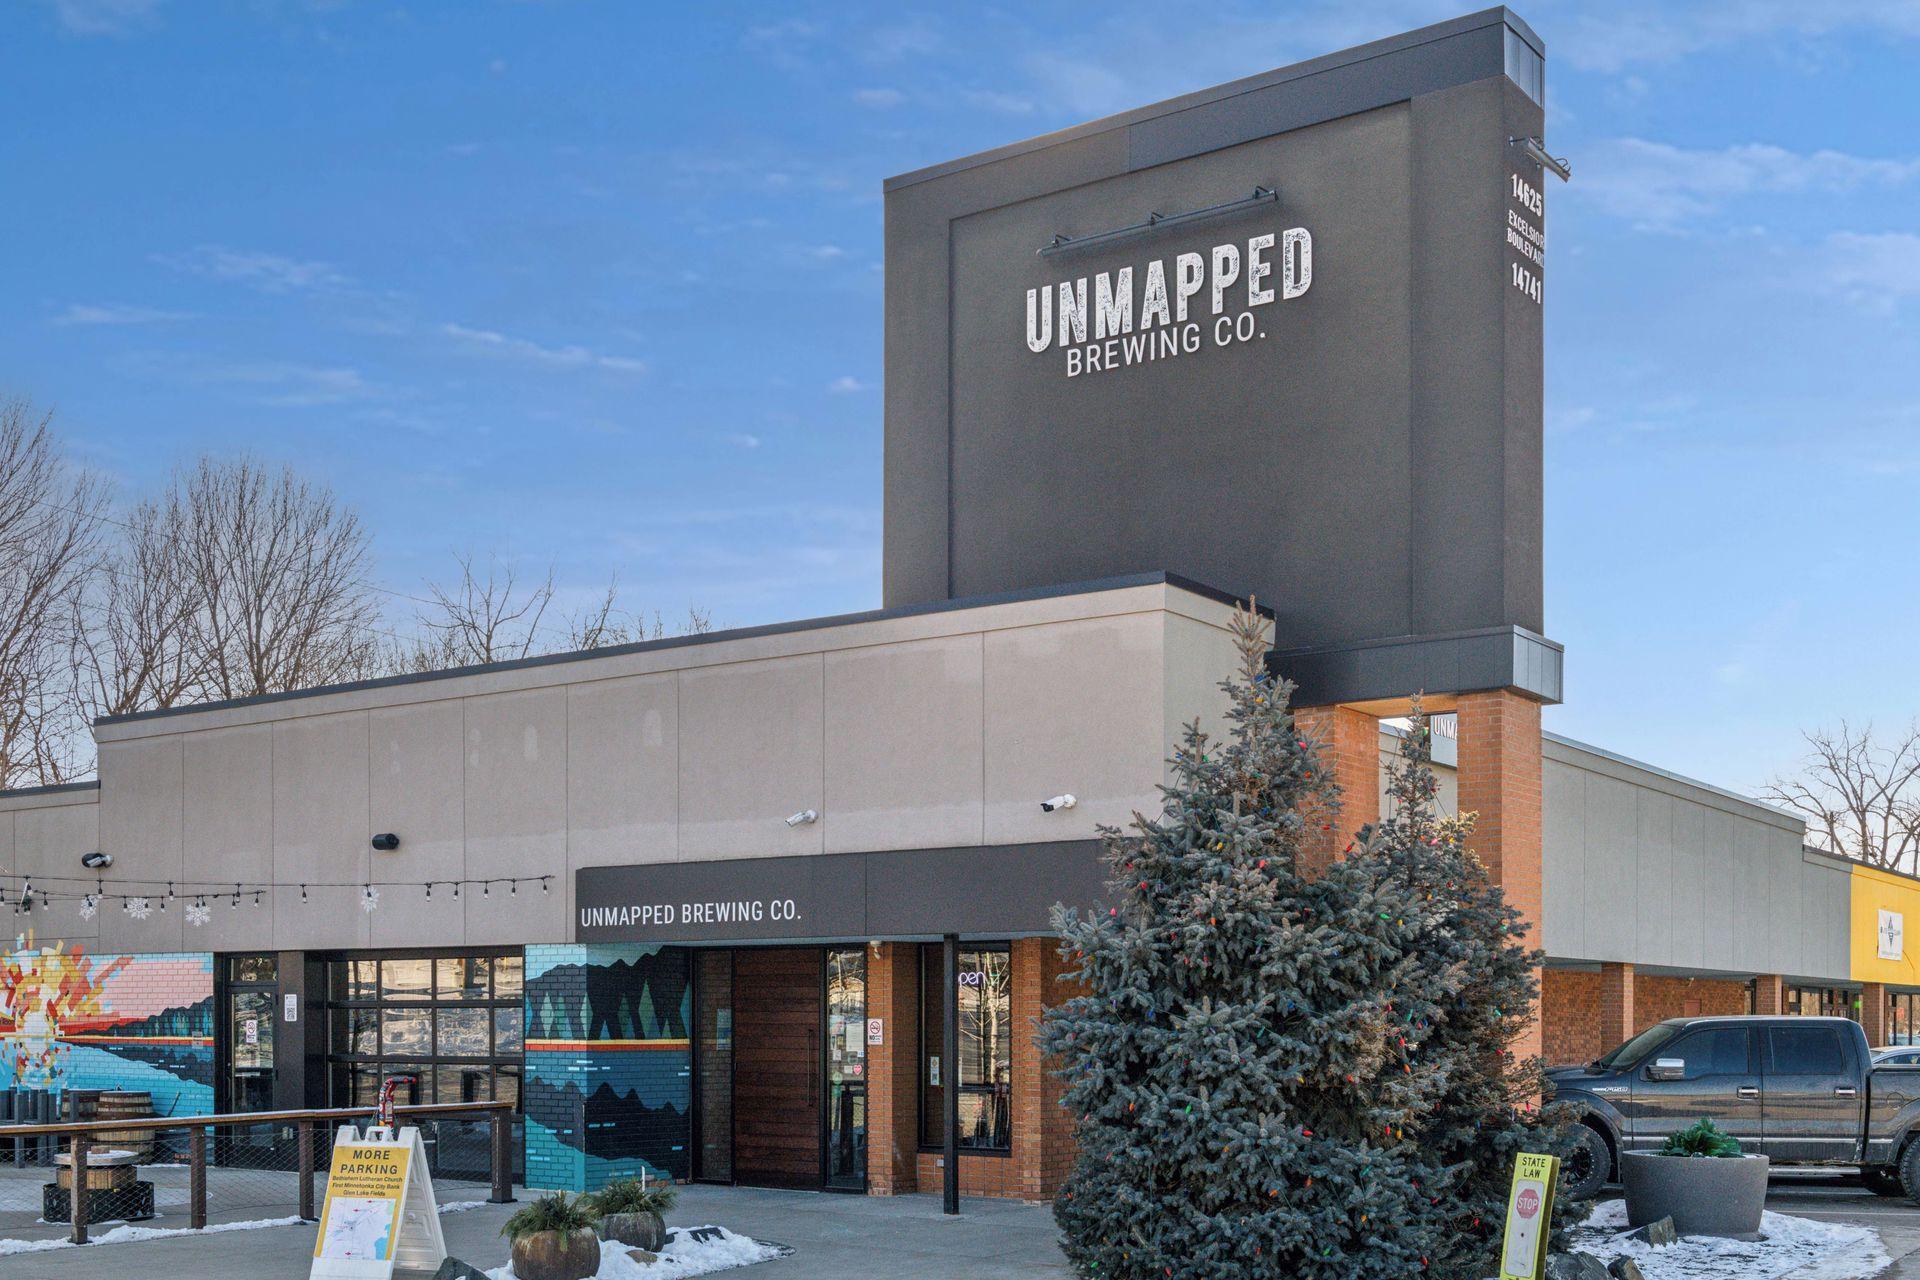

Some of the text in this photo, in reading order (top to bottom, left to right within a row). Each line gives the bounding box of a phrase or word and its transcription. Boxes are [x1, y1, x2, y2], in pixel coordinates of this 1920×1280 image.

[1511, 173, 1542, 217] 14625
[1508, 209, 1544, 248] EXCELSIOR
[1027, 227, 1312, 353] UNMAPPED
[1512, 262, 1541, 304] 14741
[1067, 311, 1266, 377] BREWING CO.
[581, 899, 802, 927] UNMAPPED BREWING CO.
[340, 1164, 398, 1174] PARKING
[353, 1150, 390, 1160] MORE
[1522, 1156, 1546, 1168] STATE
[1523, 1169, 1541, 1178] LAW
[1517, 1197, 1538, 1210] STOP
